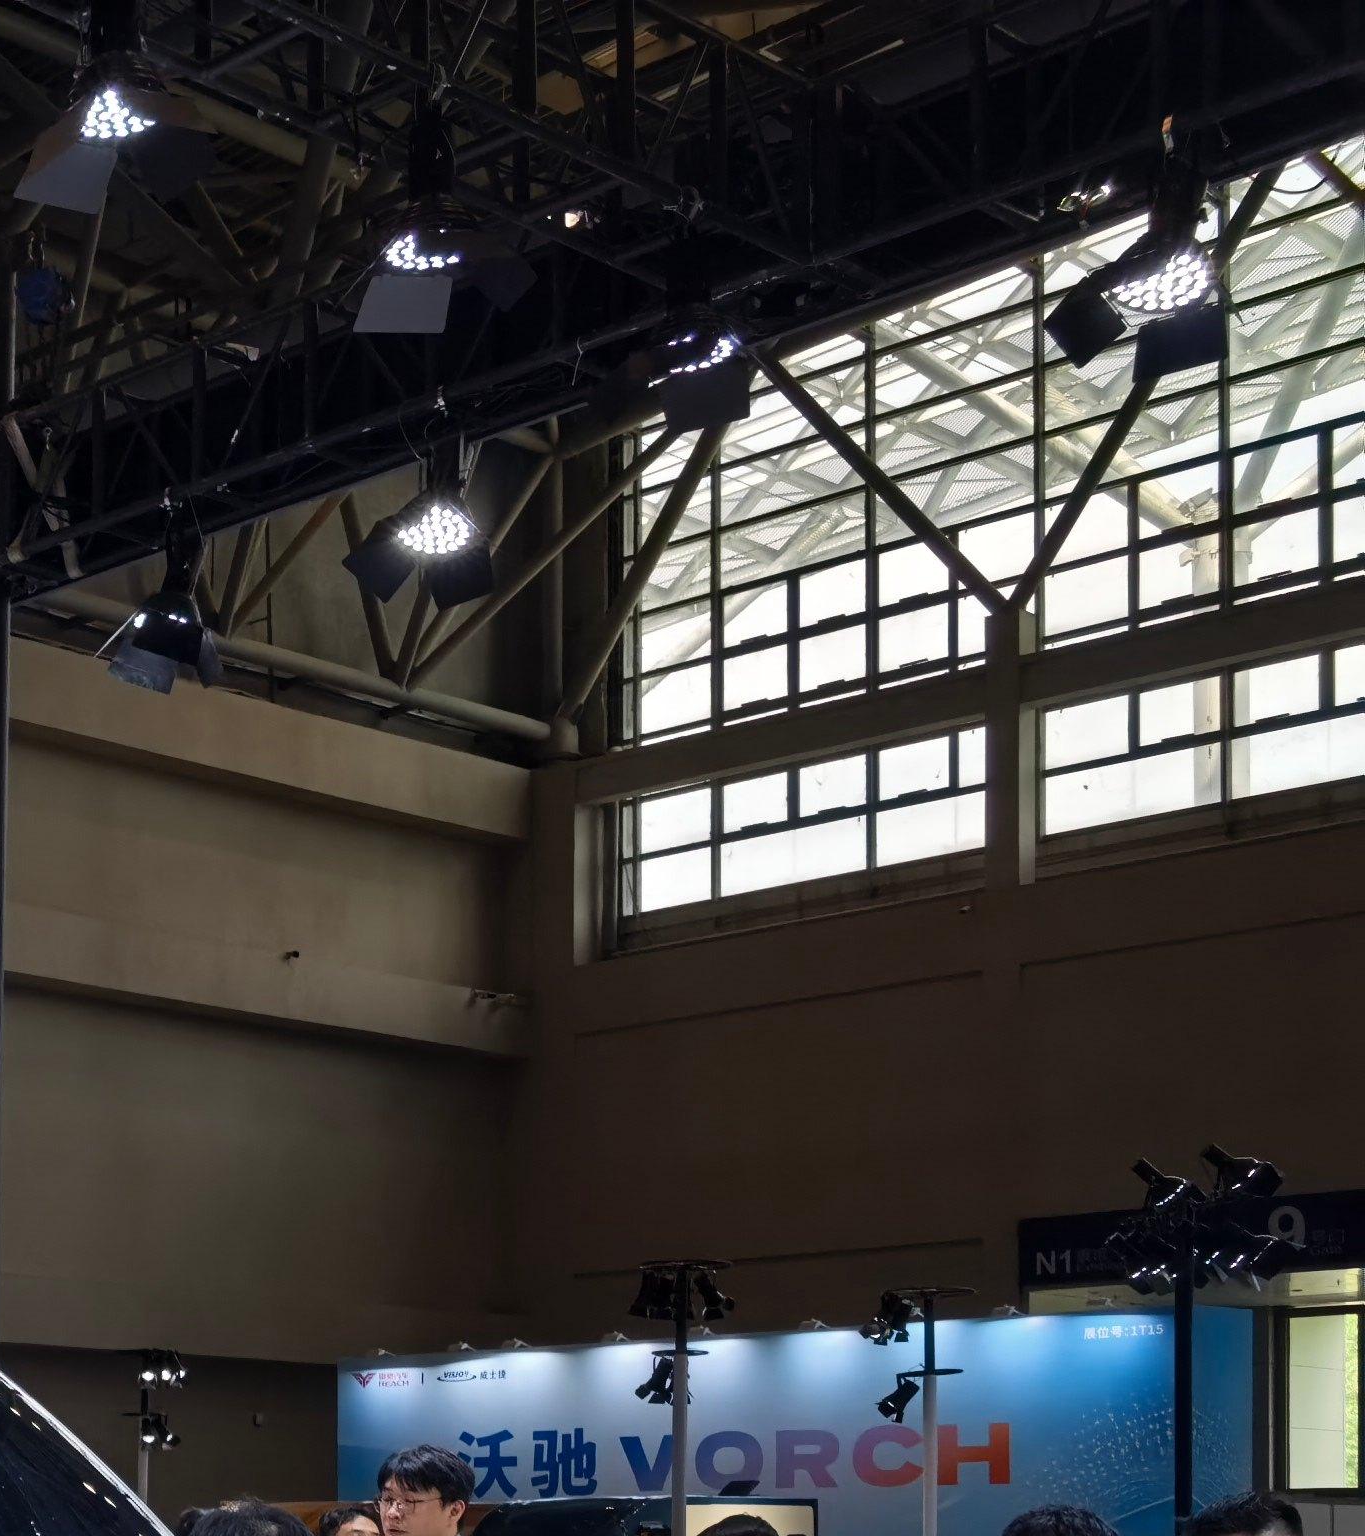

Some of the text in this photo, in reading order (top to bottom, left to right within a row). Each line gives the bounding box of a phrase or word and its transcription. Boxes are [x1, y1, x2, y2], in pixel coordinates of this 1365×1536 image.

[1267, 1205, 1306, 1250] 9
[1036, 1249, 1071, 1276] N1
[458, 1427, 598, 1498] 沃驰
[619, 1422, 1011, 1493] VORCH
